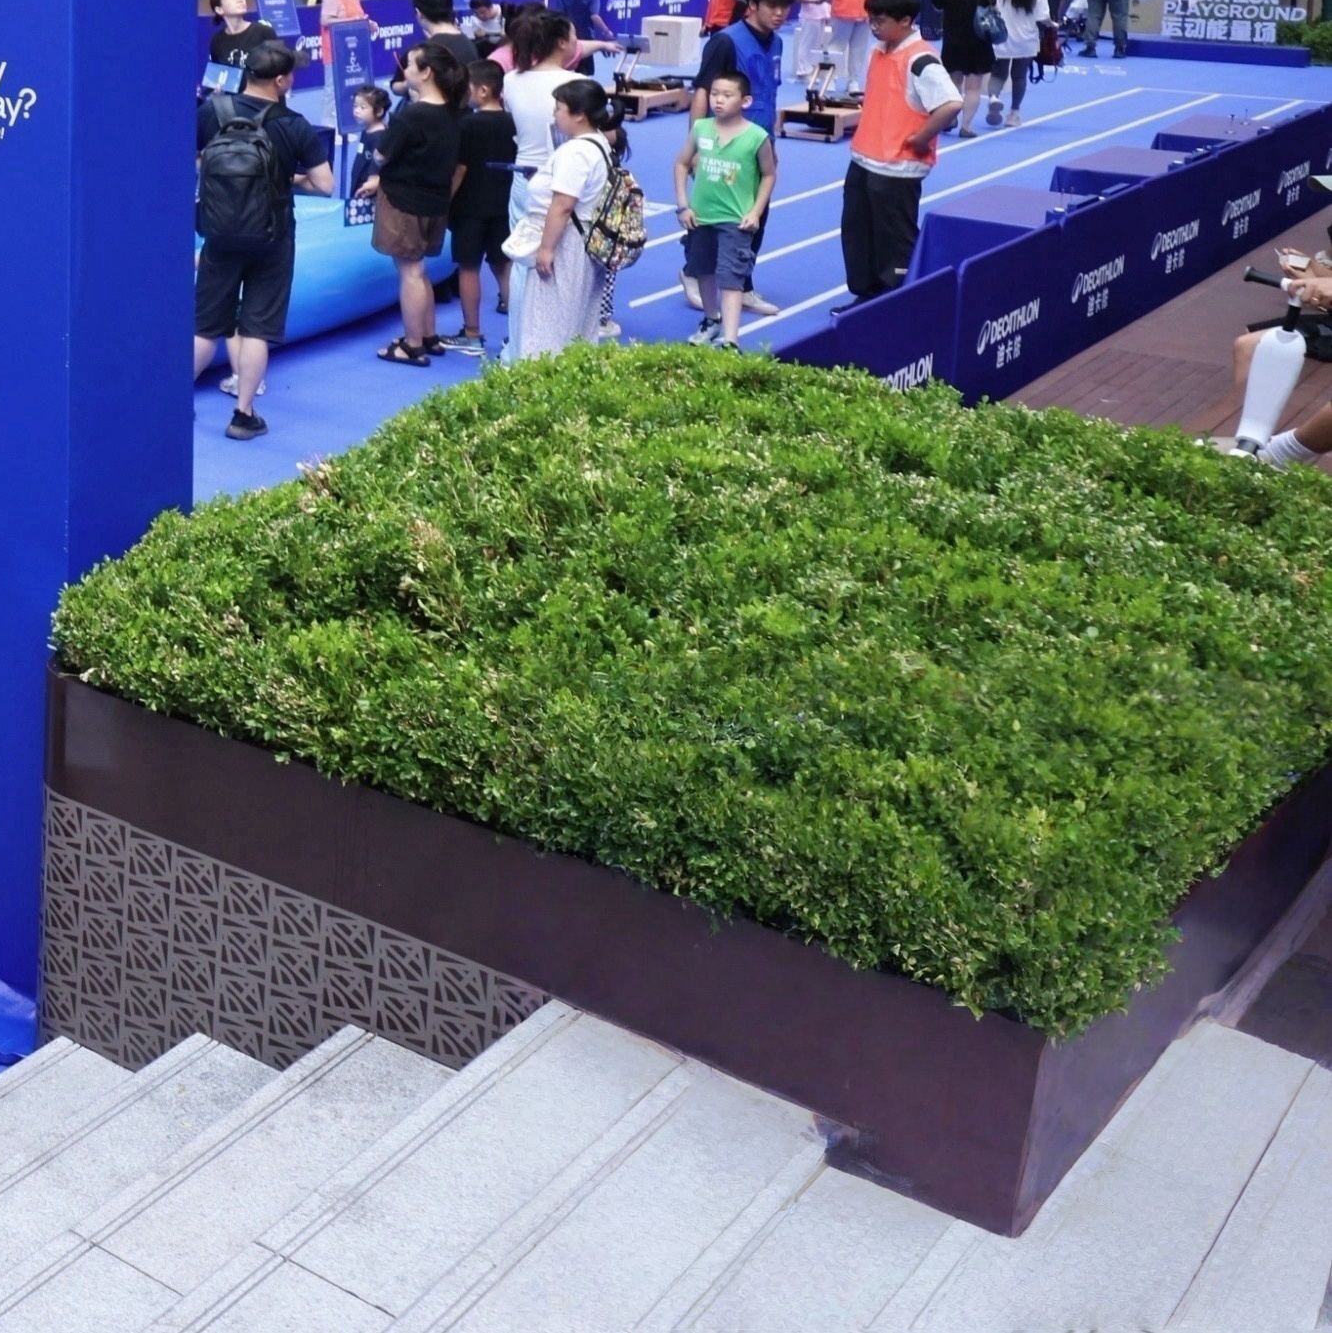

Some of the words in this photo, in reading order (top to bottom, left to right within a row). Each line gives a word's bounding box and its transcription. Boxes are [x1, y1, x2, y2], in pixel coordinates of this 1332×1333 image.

[1163, 1, 1307, 22] PLAYGROUND
[379, 23, 414, 39] DECATHLON
[1162, 18, 1277, 43] 运动能量场
[1284, 160, 1311, 189] DECATHLON
[1230, 188, 1262, 220] DECATHLON
[1161, 219, 1200, 251] DECATHLON
[1082, 254, 1125, 294] DECATHLON
[989, 297, 1040, 345] DECATHLON
[996, 334, 1022, 369] 迪卡侬
